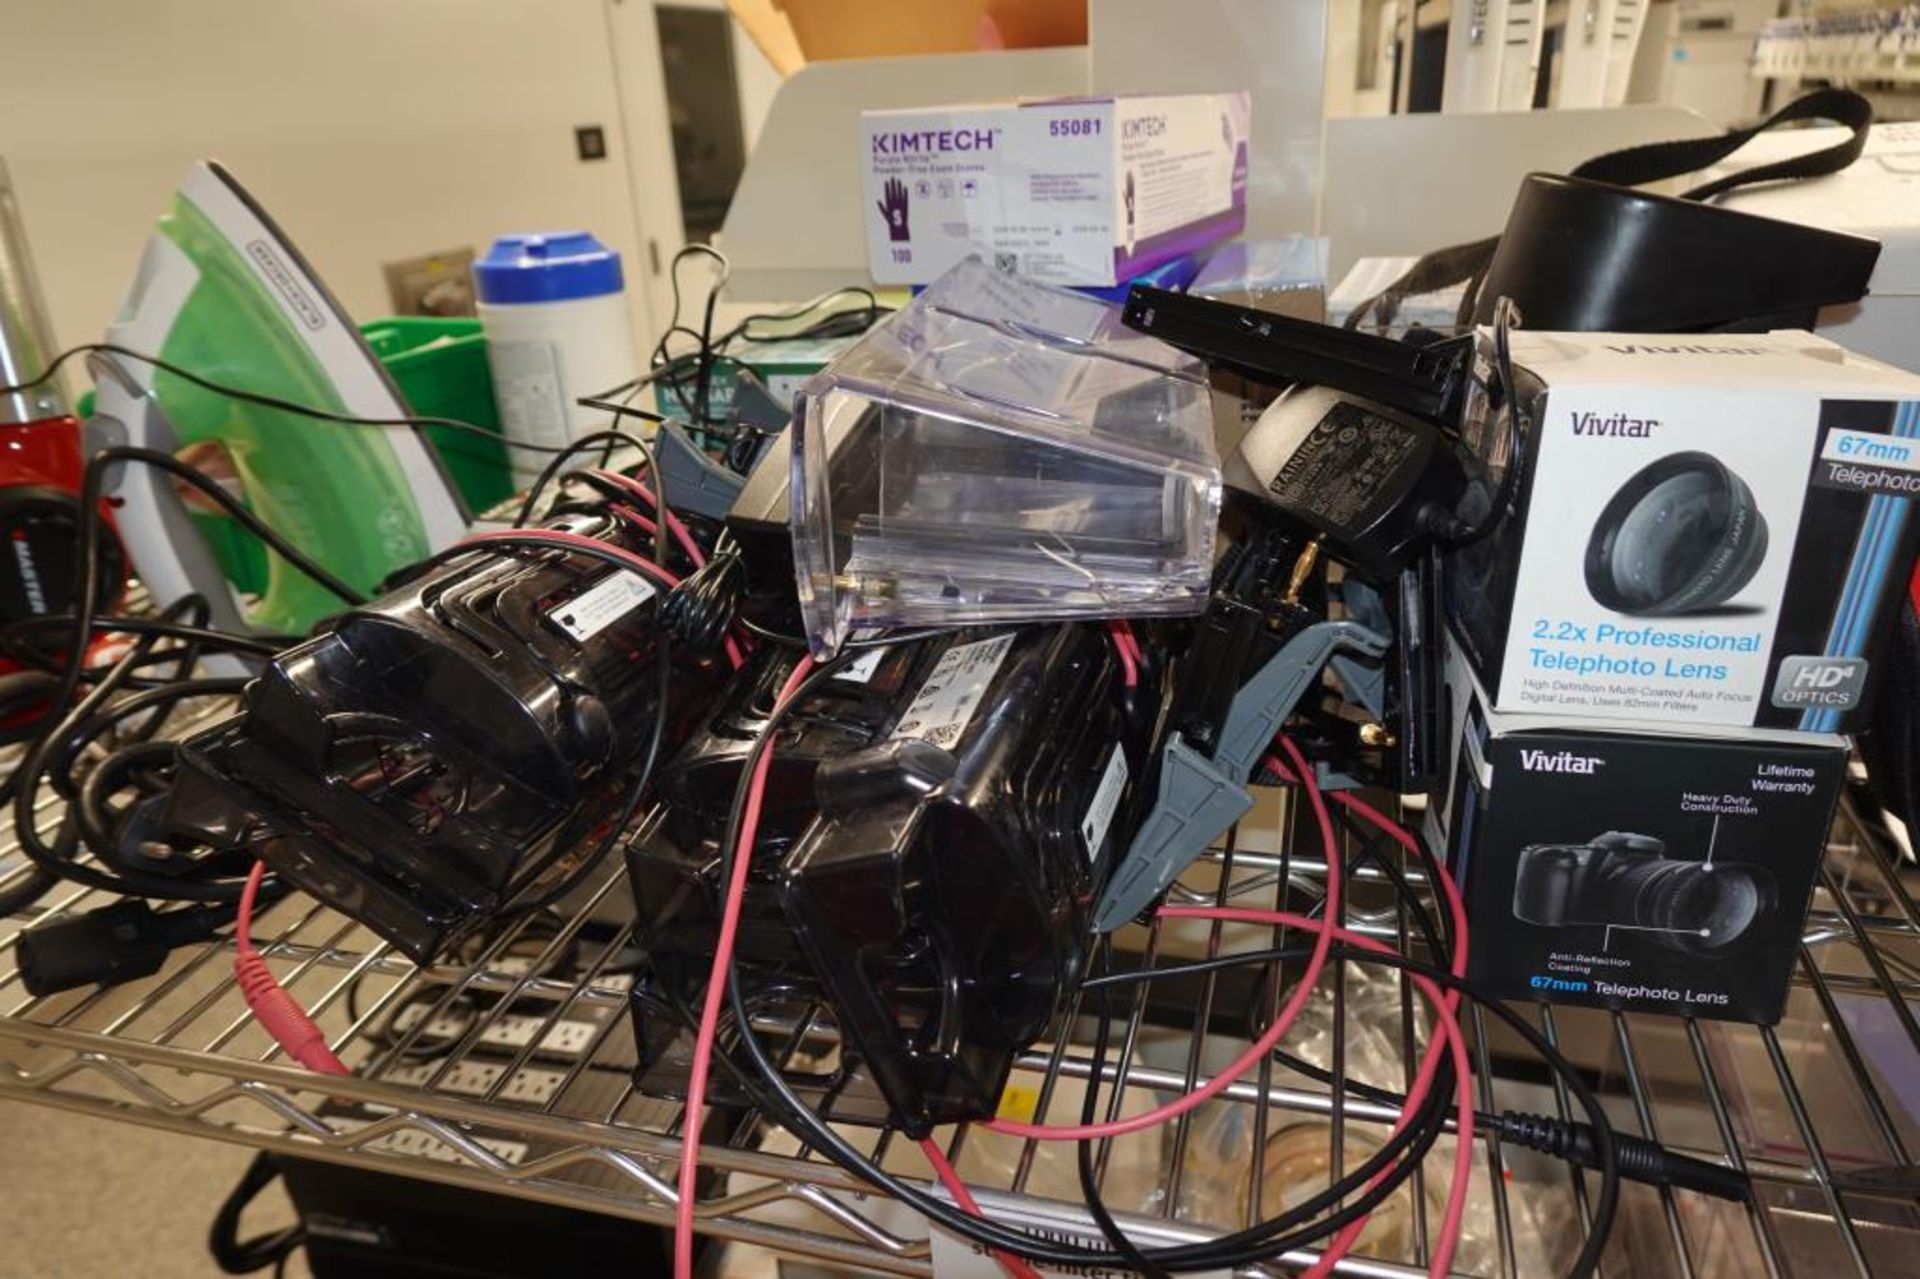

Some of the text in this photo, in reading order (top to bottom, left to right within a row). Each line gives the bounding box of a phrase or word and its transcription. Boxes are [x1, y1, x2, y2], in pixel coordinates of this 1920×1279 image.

[1049, 118, 1101, 136] 55081
[892, 209, 903, 226] S
[892, 248, 912, 264] 100
[1571, 411, 1660, 438] Vivitar
[1838, 436, 1911, 461] 67mm
[1828, 462, 1920, 493] Telephoto
[1532, 619, 1762, 652] 2.2x Professional
[1530, 648, 1728, 681] Telephoto Lens
[1520, 691, 1557, 704] Digital
[1523, 678, 1753, 703] High Definition Multi-Coated Auto Focus
[1782, 690, 1850, 704] OPTICS
[1520, 749, 1605, 775] Vivitar
[1757, 764, 1815, 778] Lifetime
[1751, 779, 1815, 796] Warranty
[1682, 792, 1752, 806] Heavy Duty
[1680, 801, 1758, 815] Construction
[1550, 952, 1631, 967] Anti-Reflection
[1548, 962, 1591, 975] Coating
[1530, 975, 1729, 1005] 67mm Telephoto Lens
